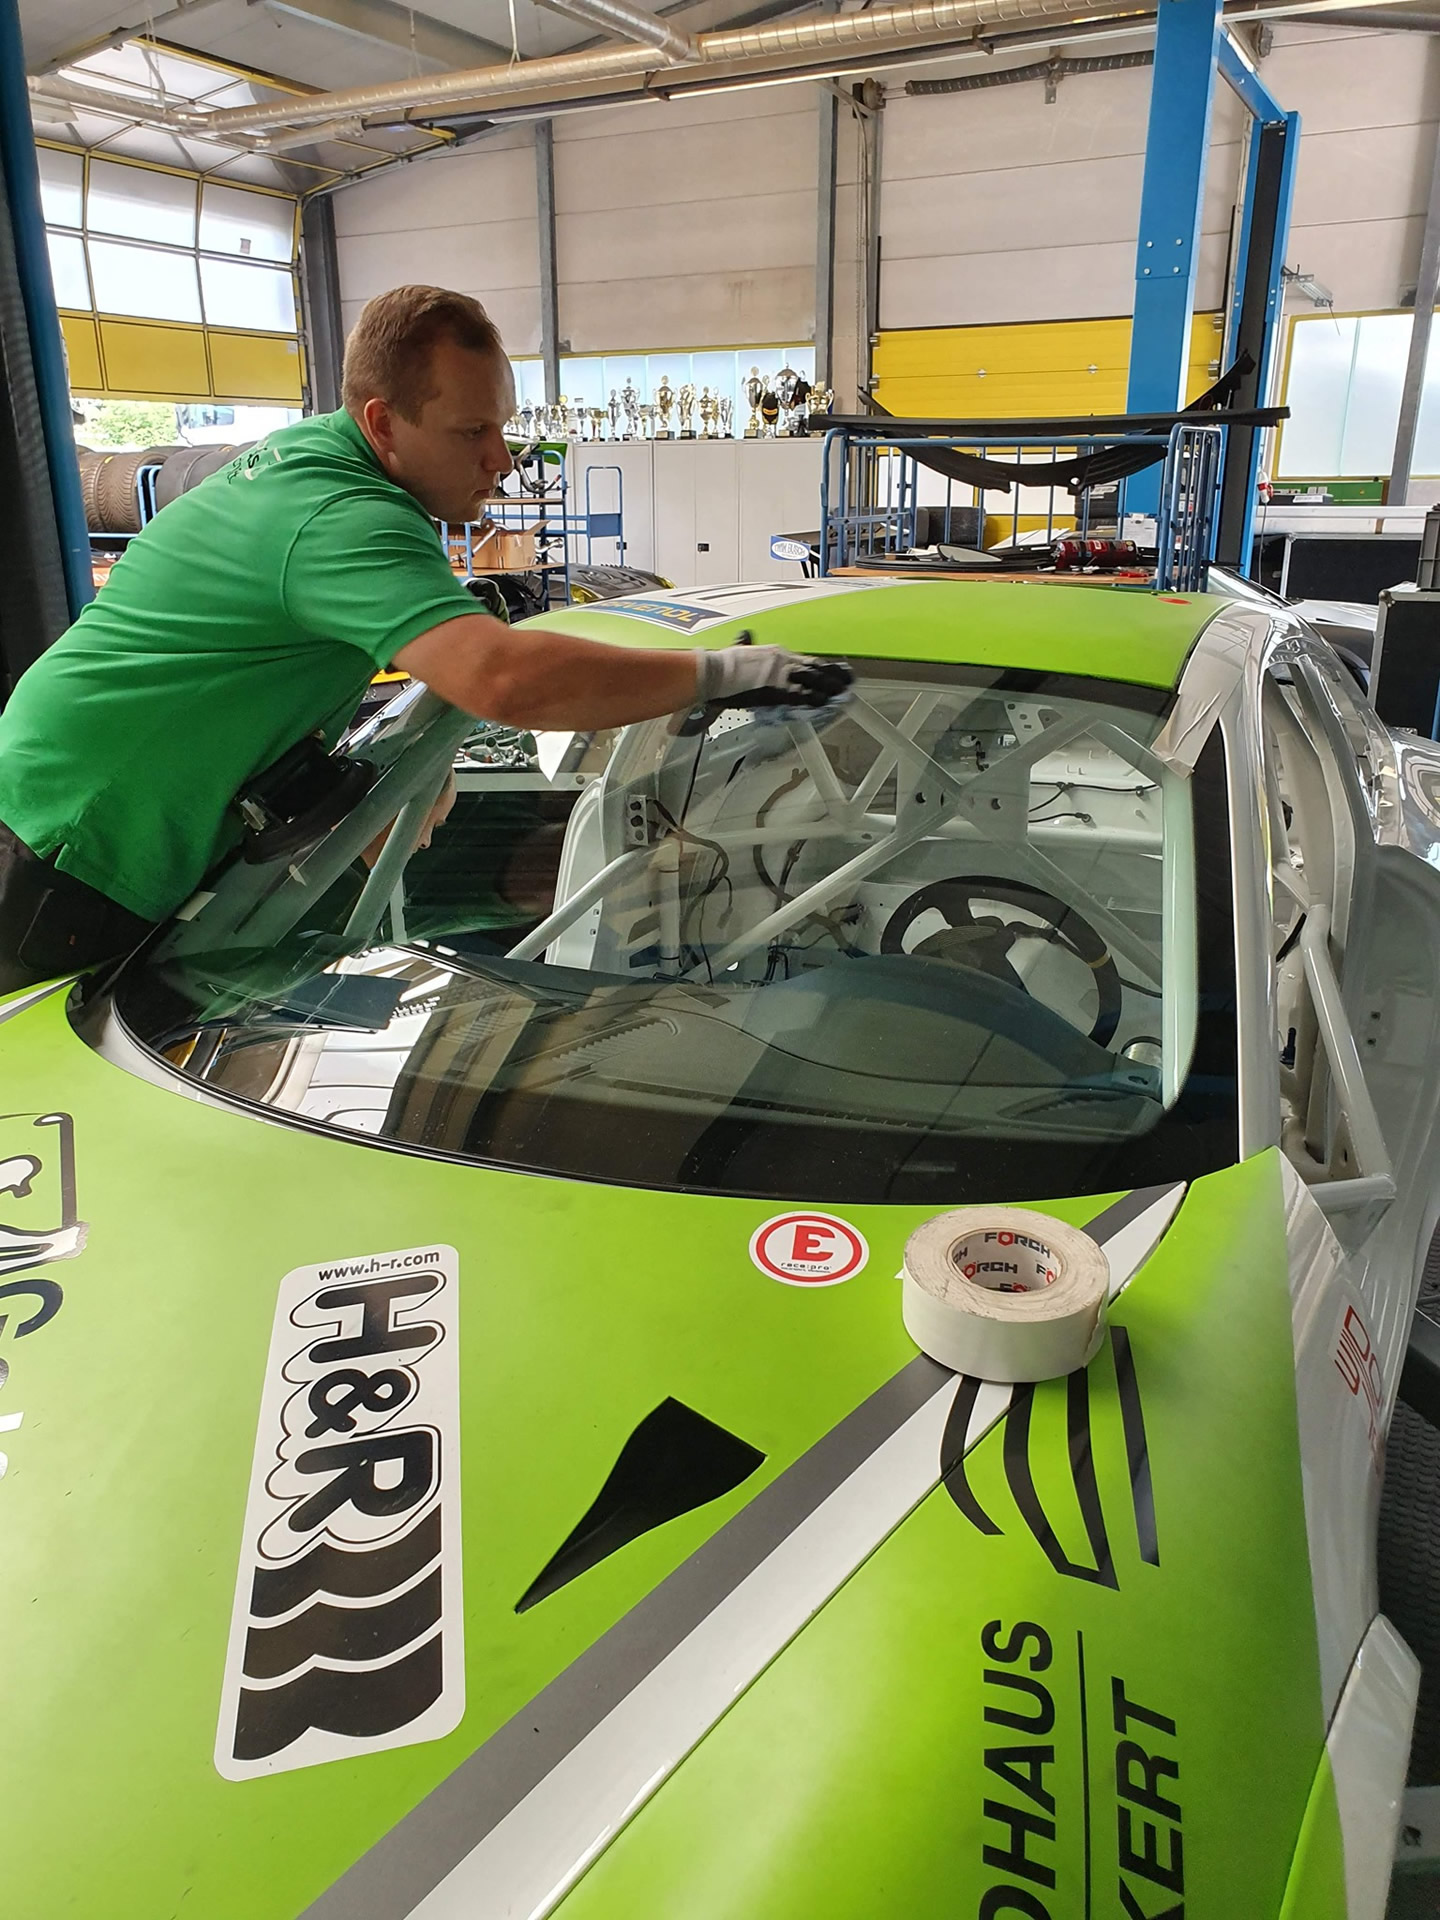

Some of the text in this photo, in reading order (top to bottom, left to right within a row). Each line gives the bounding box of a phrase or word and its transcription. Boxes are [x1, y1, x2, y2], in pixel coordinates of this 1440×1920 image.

[791, 1224, 836, 1262] E
[318, 1251, 440, 1282] www.h-r.com
[280, 1271, 444, 1542] H&R
